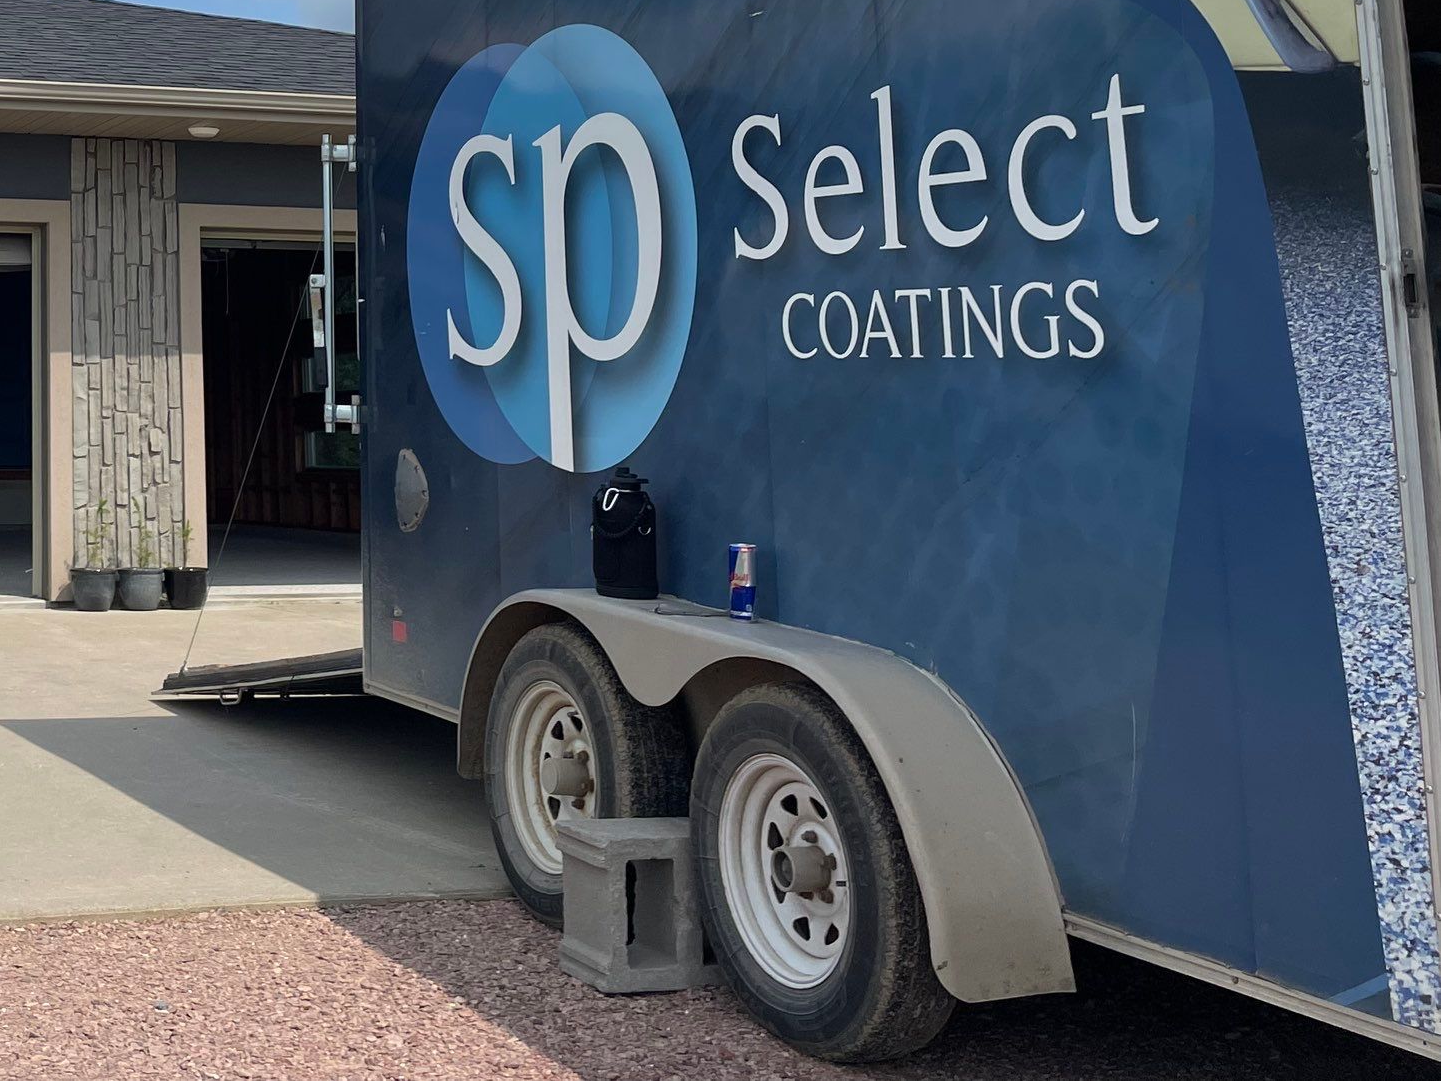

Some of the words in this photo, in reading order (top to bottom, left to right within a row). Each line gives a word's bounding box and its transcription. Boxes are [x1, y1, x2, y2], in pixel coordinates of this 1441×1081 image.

[731, 73, 1161, 261] Select
[446, 111, 663, 473] sp
[781, 279, 1106, 360] COATINGS
